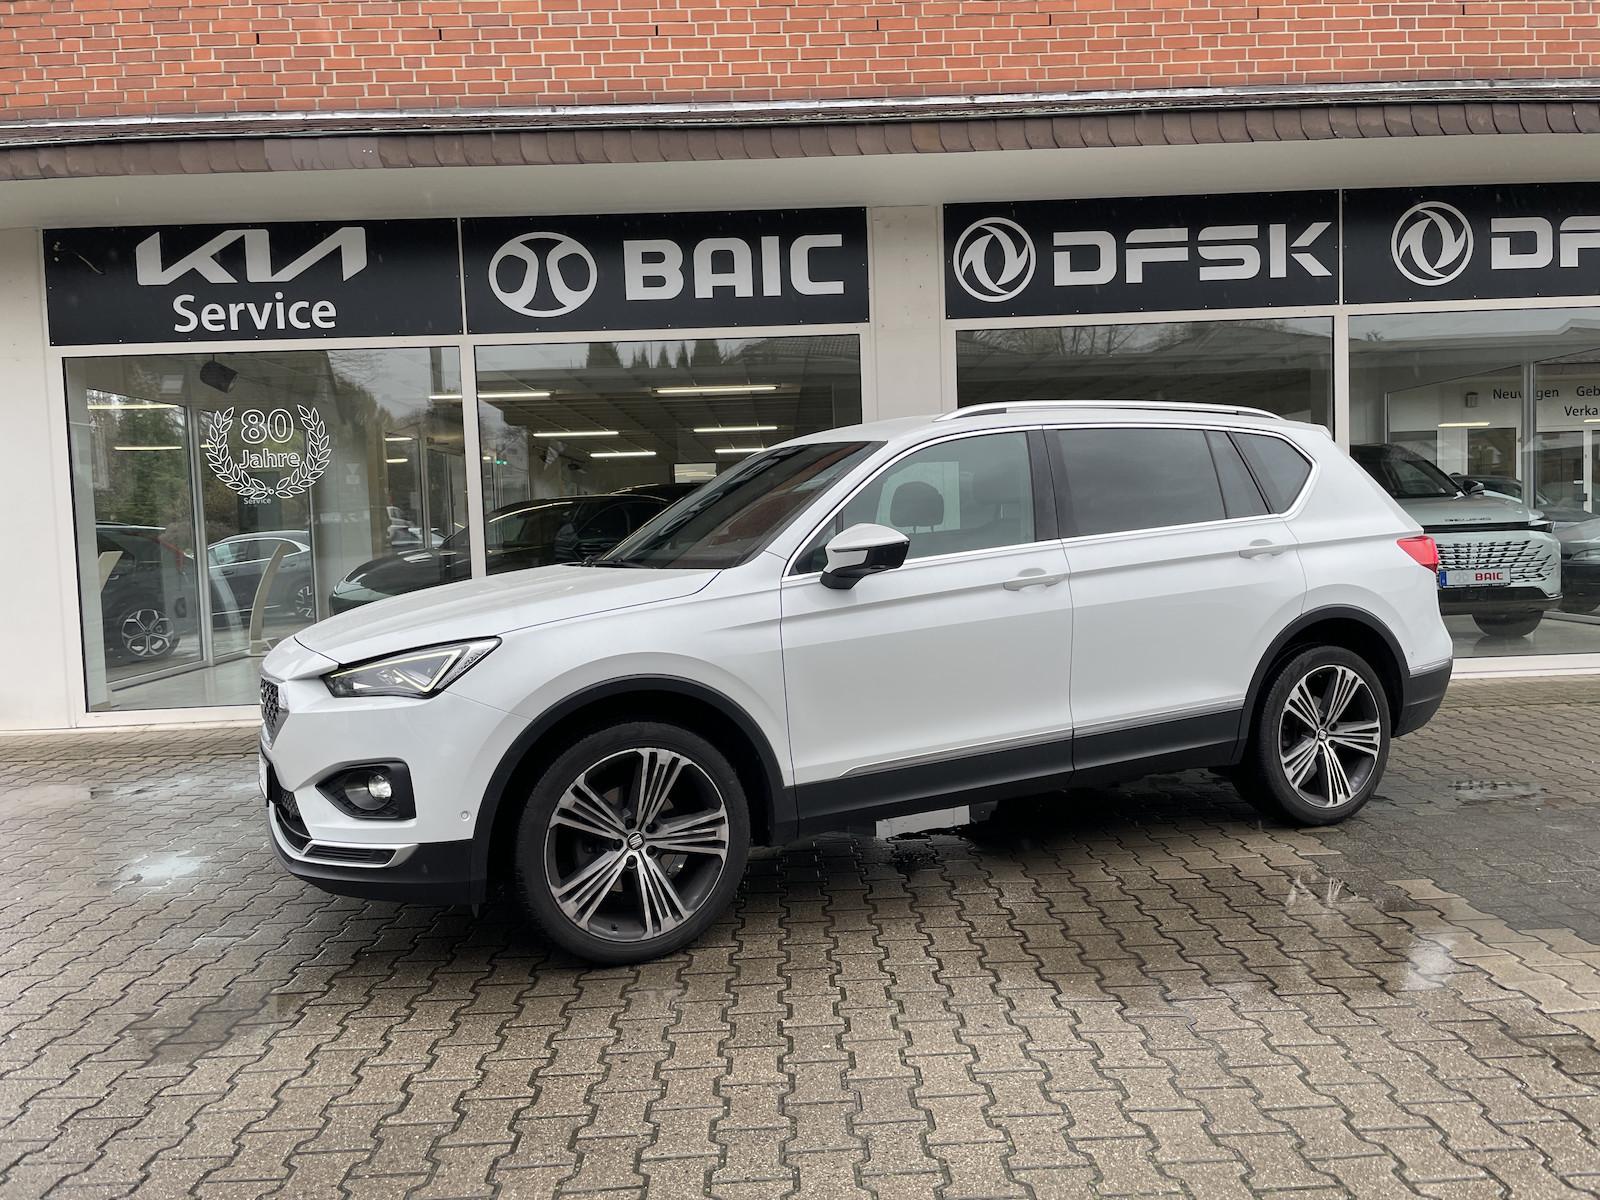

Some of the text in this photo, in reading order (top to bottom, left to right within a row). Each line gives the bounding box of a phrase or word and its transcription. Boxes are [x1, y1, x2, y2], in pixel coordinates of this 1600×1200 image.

[136, 227, 367, 285] KIA
[624, 234, 844, 300] BAIC
[1054, 222, 1332, 287] DFSK
[173, 292, 337, 332] Service
[1493, 388, 1559, 401] Neugen
[241, 408, 294, 444] 80
[239, 448, 300, 469] Jahre
[1475, 572, 1503, 581] BAIC
